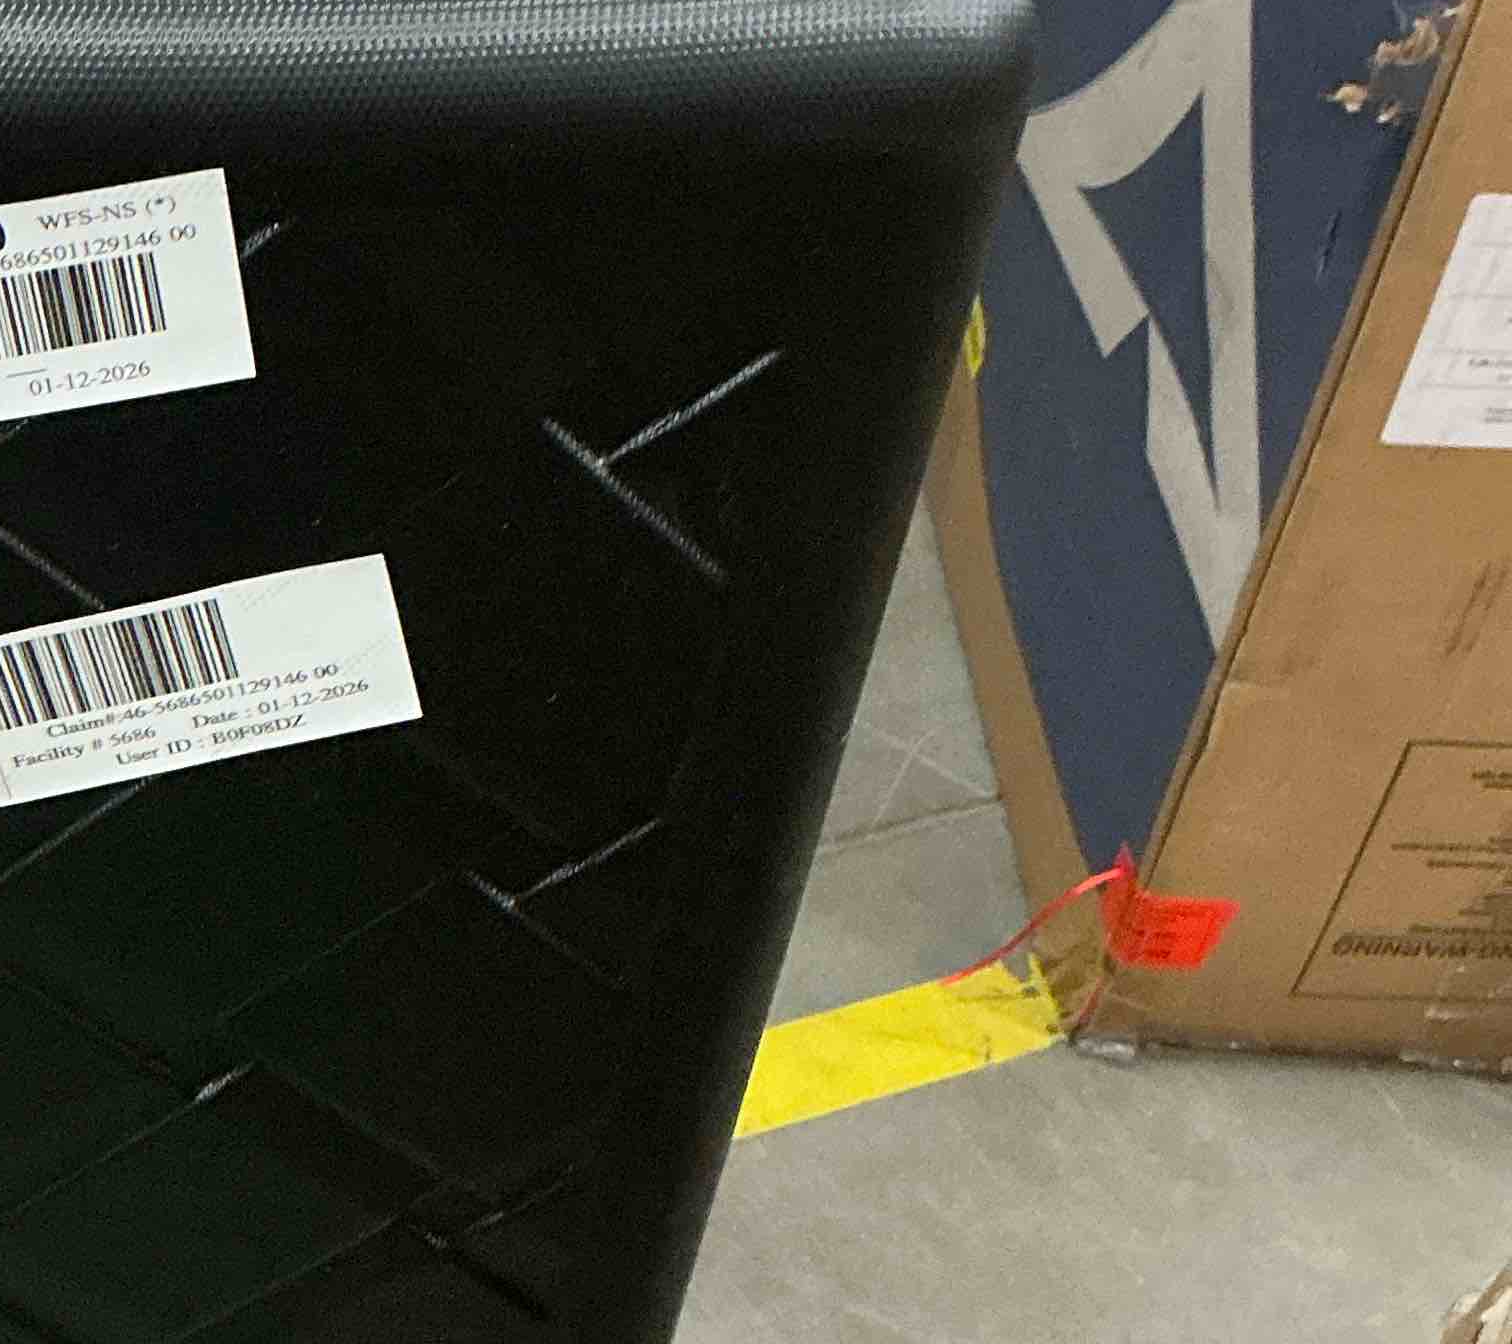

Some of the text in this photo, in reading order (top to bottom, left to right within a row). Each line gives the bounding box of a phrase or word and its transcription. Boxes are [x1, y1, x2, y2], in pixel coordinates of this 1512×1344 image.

[36, 201, 138, 232] WFS-NS
[168, 223, 198, 243] 00
[28, 359, 152, 398] 01-12-2026
[313, 663, 339, 681] 00
[12, 743, 86, 769] Facility
[109, 725, 157, 748] 5686
[191, 710, 240, 730] Date
[257, 678, 370, 716] 01-12-2026
[114, 747, 161, 766] User
[167, 737, 193, 756] ID
